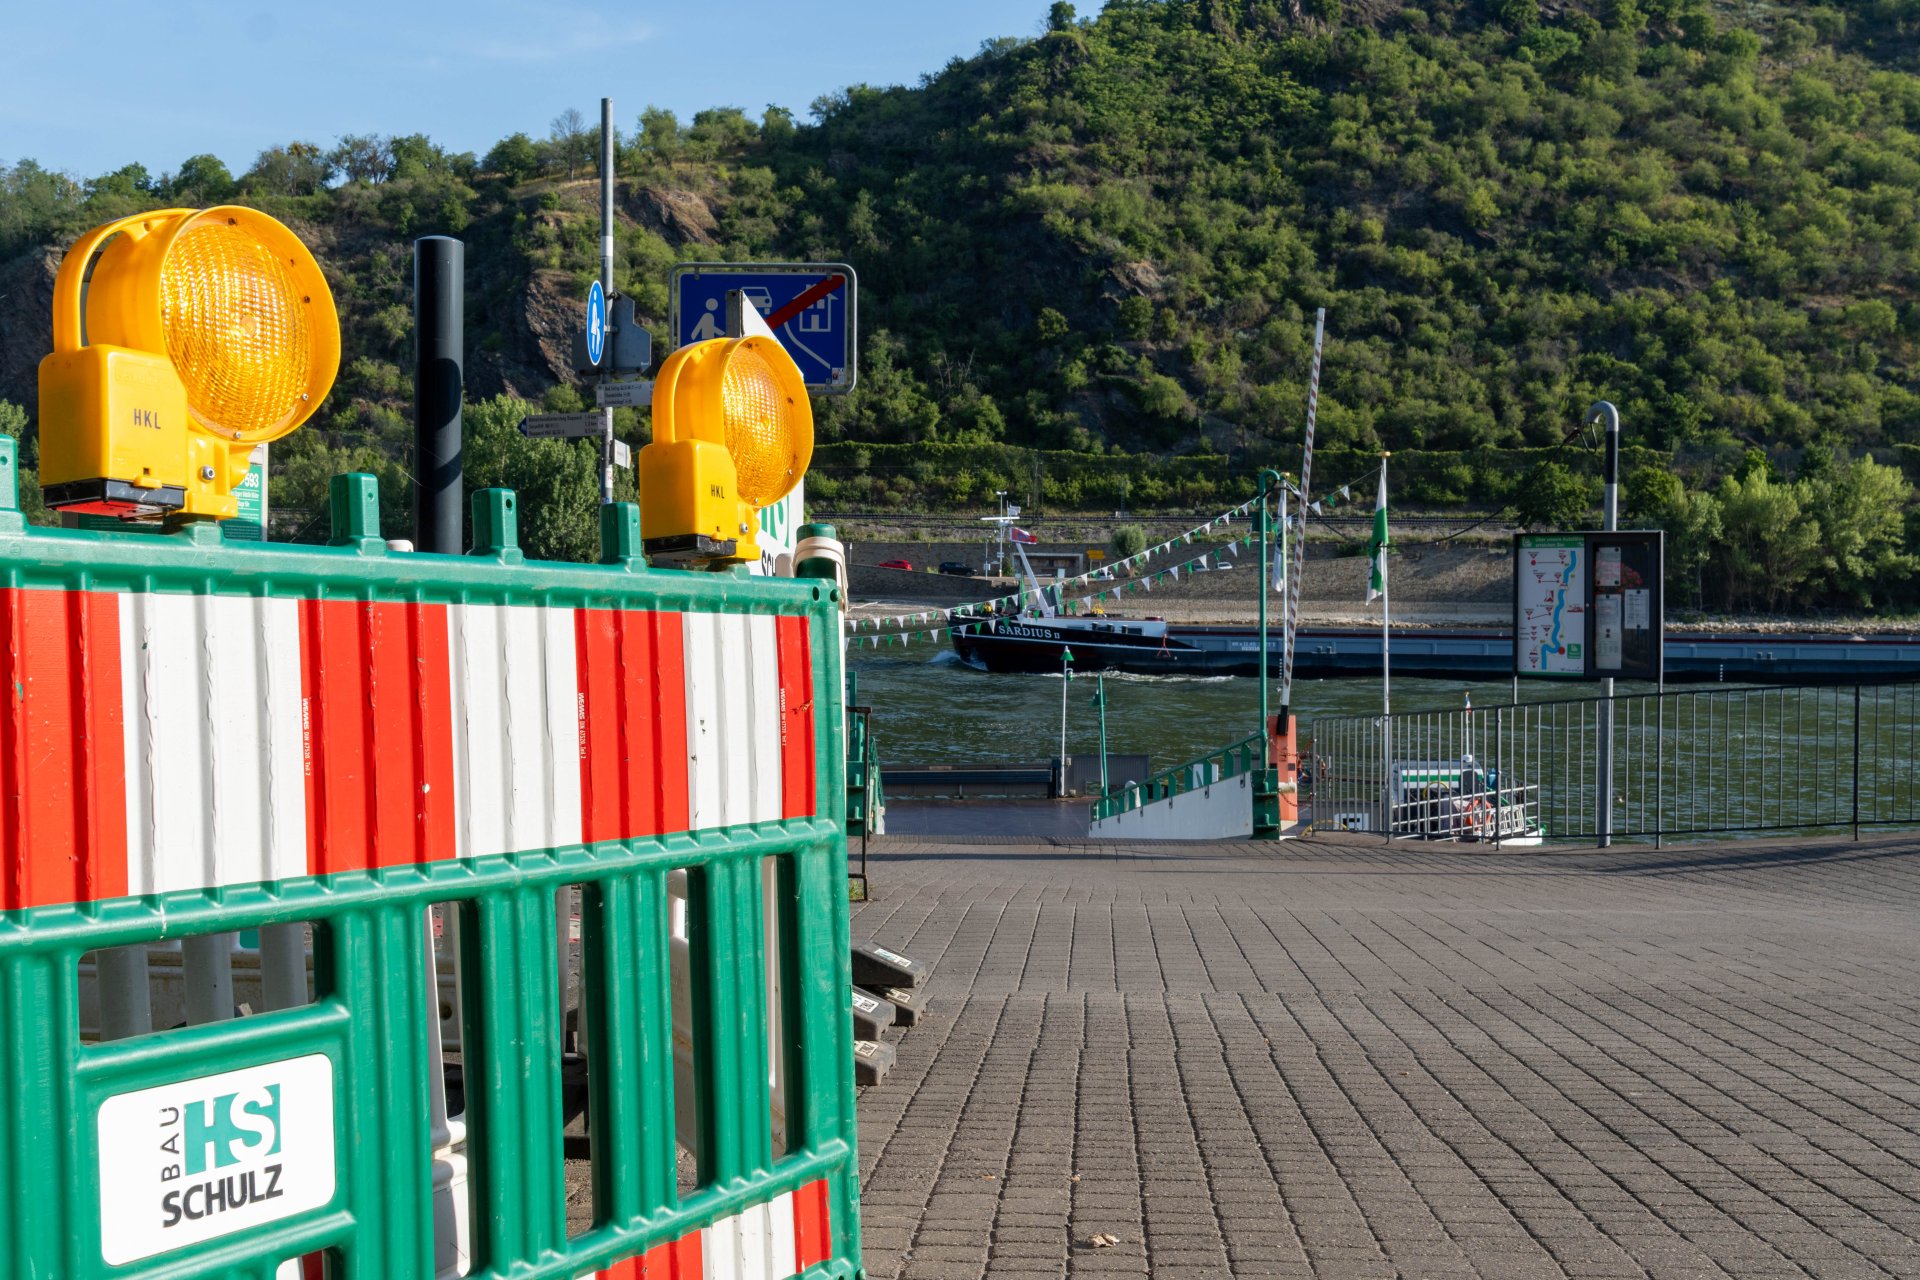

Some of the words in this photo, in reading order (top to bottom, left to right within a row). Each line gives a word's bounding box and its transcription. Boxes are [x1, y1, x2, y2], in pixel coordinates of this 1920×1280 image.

[133, 408, 161, 430] HKL
[710, 483, 725, 499] HKL
[998, 625, 1052, 639] SARDIUS
[302, 698, 310, 729] WEMAS
[159, 1106, 181, 1182] BAU
[184, 1083, 281, 1176] HS
[162, 1163, 283, 1228] SCHULZ
